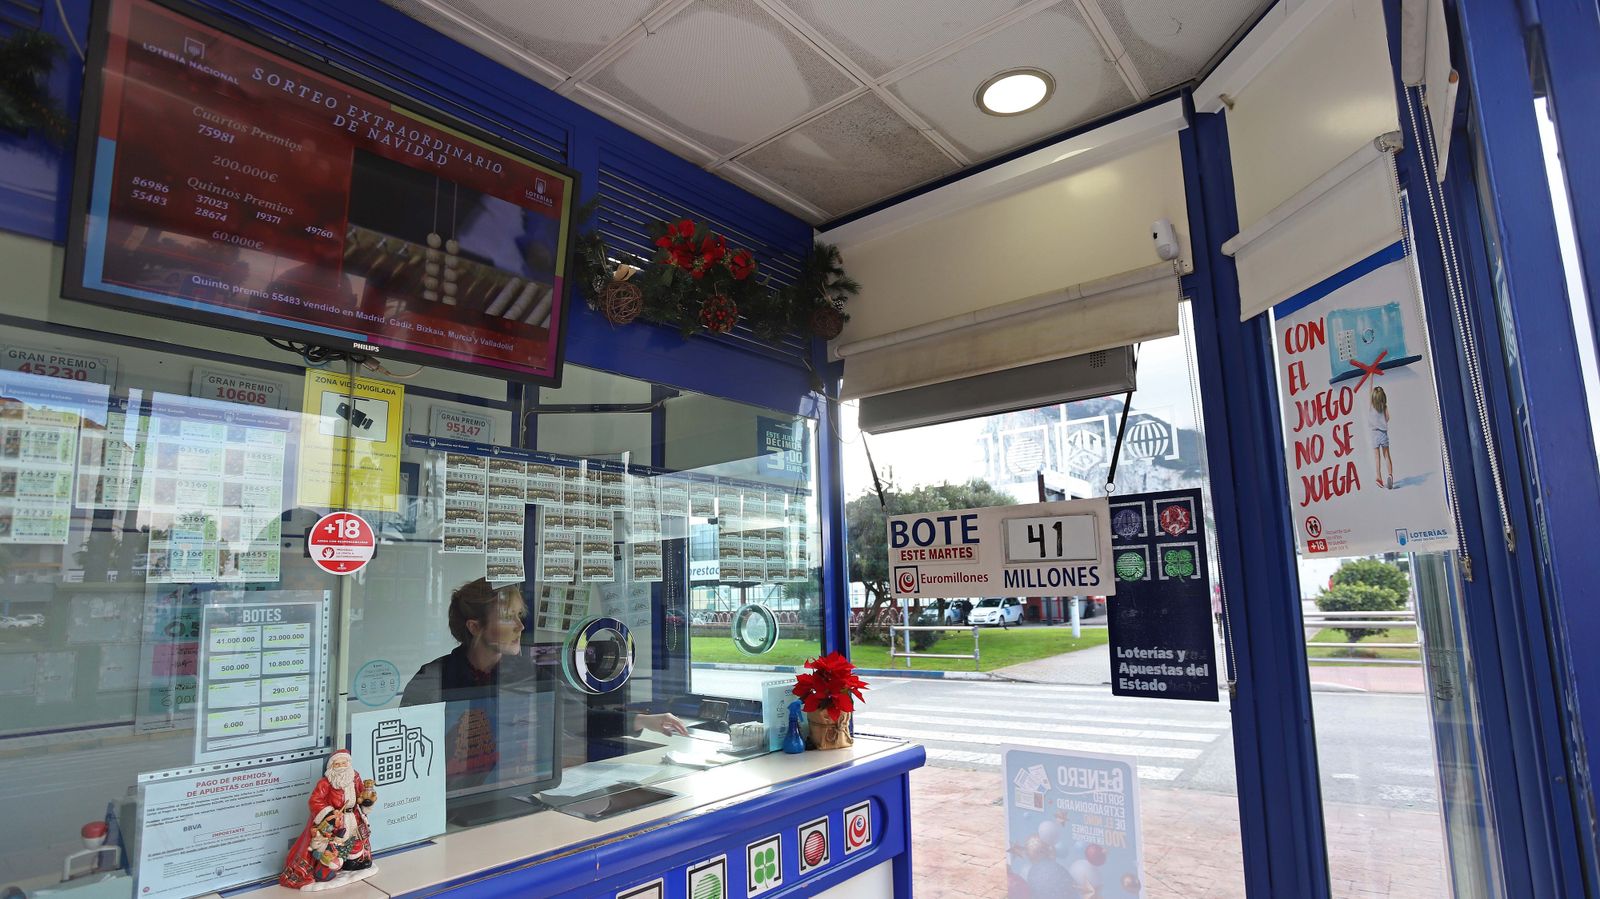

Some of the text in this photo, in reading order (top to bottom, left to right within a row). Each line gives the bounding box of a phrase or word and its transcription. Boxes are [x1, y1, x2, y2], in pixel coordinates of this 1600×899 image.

[189, 60, 239, 85] NACIONAL
[192, 106, 303, 152] Cuartos Premios
[251, 67, 502, 174] SORTEO EXTRAORDINARIO
[197, 124, 235, 144] 75981
[333, 114, 447, 166] DE NAVIDAD
[211, 155, 279, 183] 200.000€
[131, 176, 169, 194] 86986
[131, 189, 168, 207] 55483
[187, 176, 294, 216] Quintos Premios
[195, 194, 229, 210] 37023
[194, 207, 228, 222] 28674
[255, 211, 281, 225] 19371
[211, 229, 264, 250] 60.000€
[305, 225, 333, 239] 49760
[192, 275, 230, 291] Quinto
[233, 285, 269, 299] premio
[271, 292, 300, 306] 55483
[303, 300, 340, 314] vendido
[342, 309, 354, 317] en
[448, 330, 472, 343] Murcia
[480, 338, 514, 351] Valladolid
[1285, 317, 1325, 355] CON
[353, 342, 380, 353] PHILIPS
[8, 350, 97, 370] GRAN PREMIO
[18, 362, 87, 381] 45230
[1288, 360, 1310, 396] EL
[208, 375, 274, 394] GRAN PREMIO
[315, 376, 397, 396] ZONA VIDEOVIGILADA
[216, 386, 267, 405] 10608
[1293, 386, 1354, 433] JUEGO
[441, 413, 486, 427] GRAN PREMIO
[446, 422, 480, 436] 95147
[1294, 422, 1354, 470] NO SE
[1300, 461, 1361, 507] JUEGA
[324, 519, 360, 538] +18
[891, 514, 980, 548] BOTE
[1409, 529, 1448, 539] LOTERÍAS
[1027, 521, 1063, 558] 41
[1311, 541, 1325, 551] +18
[901, 546, 973, 561] ESTE MARTES
[920, 572, 989, 584] Euromillones
[1004, 566, 1100, 588] MILLONES
[242, 608, 282, 623] BOTES
[216, 637, 255, 645] 41.000.000
[268, 633, 304, 641] 23.000.000
[1117, 646, 1187, 663] Loterías y
[221, 664, 249, 672] 500.000
[1119, 662, 1209, 677] Apuestas del
[272, 686, 299, 694] 290.000
[1119, 678, 1167, 692] Estado
[223, 721, 244, 729] 6.000
[186, 790, 199, 798] DE
[199, 784, 239, 796] APUESTAS
[256, 777, 280, 786] BIZUM
[196, 778, 217, 788] PAGO
[220, 777, 231, 785] DE
[232, 771, 266, 782] PREMIOS
[255, 809, 279, 818] BANKIA
[183, 824, 202, 832] BBVA
